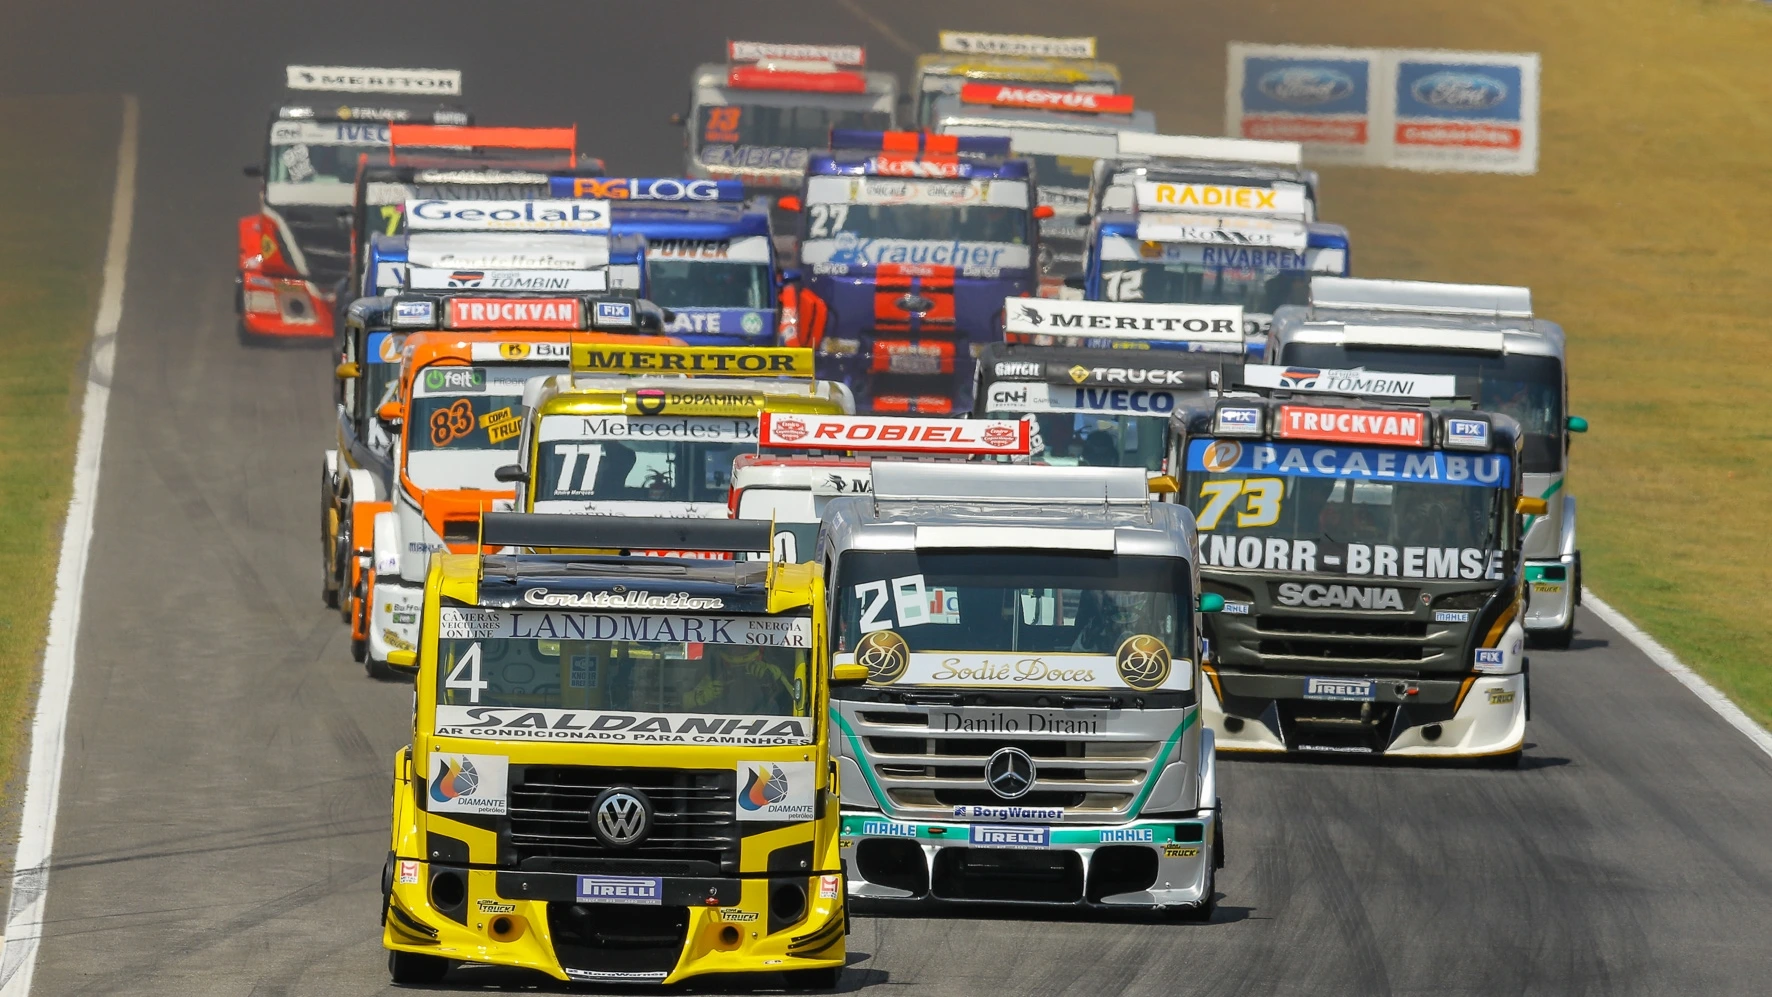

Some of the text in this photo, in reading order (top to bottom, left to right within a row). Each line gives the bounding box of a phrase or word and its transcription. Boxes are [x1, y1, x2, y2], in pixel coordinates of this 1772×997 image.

[321, 73, 453, 90] MERITOR
[996, 87, 1098, 109] MOTUL
[337, 124, 391, 142] IVEC
[1156, 183, 1278, 209] RADIEX
[412, 201, 602, 222] Geolab
[810, 204, 849, 237] 27
[646, 239, 731, 258] POWER
[857, 240, 1006, 266] Kraucher
[1203, 247, 1307, 268] RIVABREN
[491, 278, 570, 289] TOMBINI
[402, 304, 427, 315] FIX
[457, 302, 573, 321] TRUCKVAN
[603, 305, 625, 317] FIX
[1050, 313, 1236, 333] MERITOR
[587, 351, 797, 372] MERITOR
[1092, 367, 1185, 385] TRUCK
[1327, 377, 1415, 395] TOMBINI
[671, 394, 756, 406] DOPAMINA
[1075, 388, 1175, 413] IVECO
[430, 398, 475, 447] 83
[488, 410, 509, 424] COPA
[1289, 411, 1416, 437] TRUCKVAN
[491, 419, 522, 439] TRUC
[814, 422, 976, 443] ROBIEL
[1455, 423, 1481, 436] FIX
[554, 444, 605, 493] 77
[1252, 446, 1500, 484] PACAEMBU
[1197, 477, 1284, 531] 73
[524, 587, 725, 610] Constellation
[855, 574, 931, 634] 28
[1277, 582, 1405, 610] SCANIA
[442, 610, 500, 622] CÂMERAS
[1224, 603, 1248, 614] AHLE
[1436, 613, 1468, 622] MAHLE
[509, 613, 736, 644] LANDMARK
[749, 620, 802, 632] ENERGIA
[745, 632, 804, 647] SOLAR
[1480, 652, 1500, 662] FIX
[445, 641, 488, 703] 4
[1012, 657, 1096, 682] Doces
[1308, 678, 1371, 696] PIRELLI
[441, 707, 806, 737] SALDANHA
[942, 712, 1098, 735] Danilo Dirani
[438, 727, 811, 746] AR CONDICIONADO PARA CAMINHÕES
[457, 797, 506, 808] DIAMANTE
[478, 806, 506, 814] petróleo
[767, 804, 813, 813] DIAMANTE
[788, 812, 814, 820] petróleo
[973, 806, 1063, 820] BorgWarner
[864, 822, 917, 837] MAHLE
[974, 825, 1045, 844] PIRELLI
[1100, 829, 1153, 842] MAHLE
[582, 878, 657, 897] PIRELLI
[482, 905, 511, 913] TRUCK
